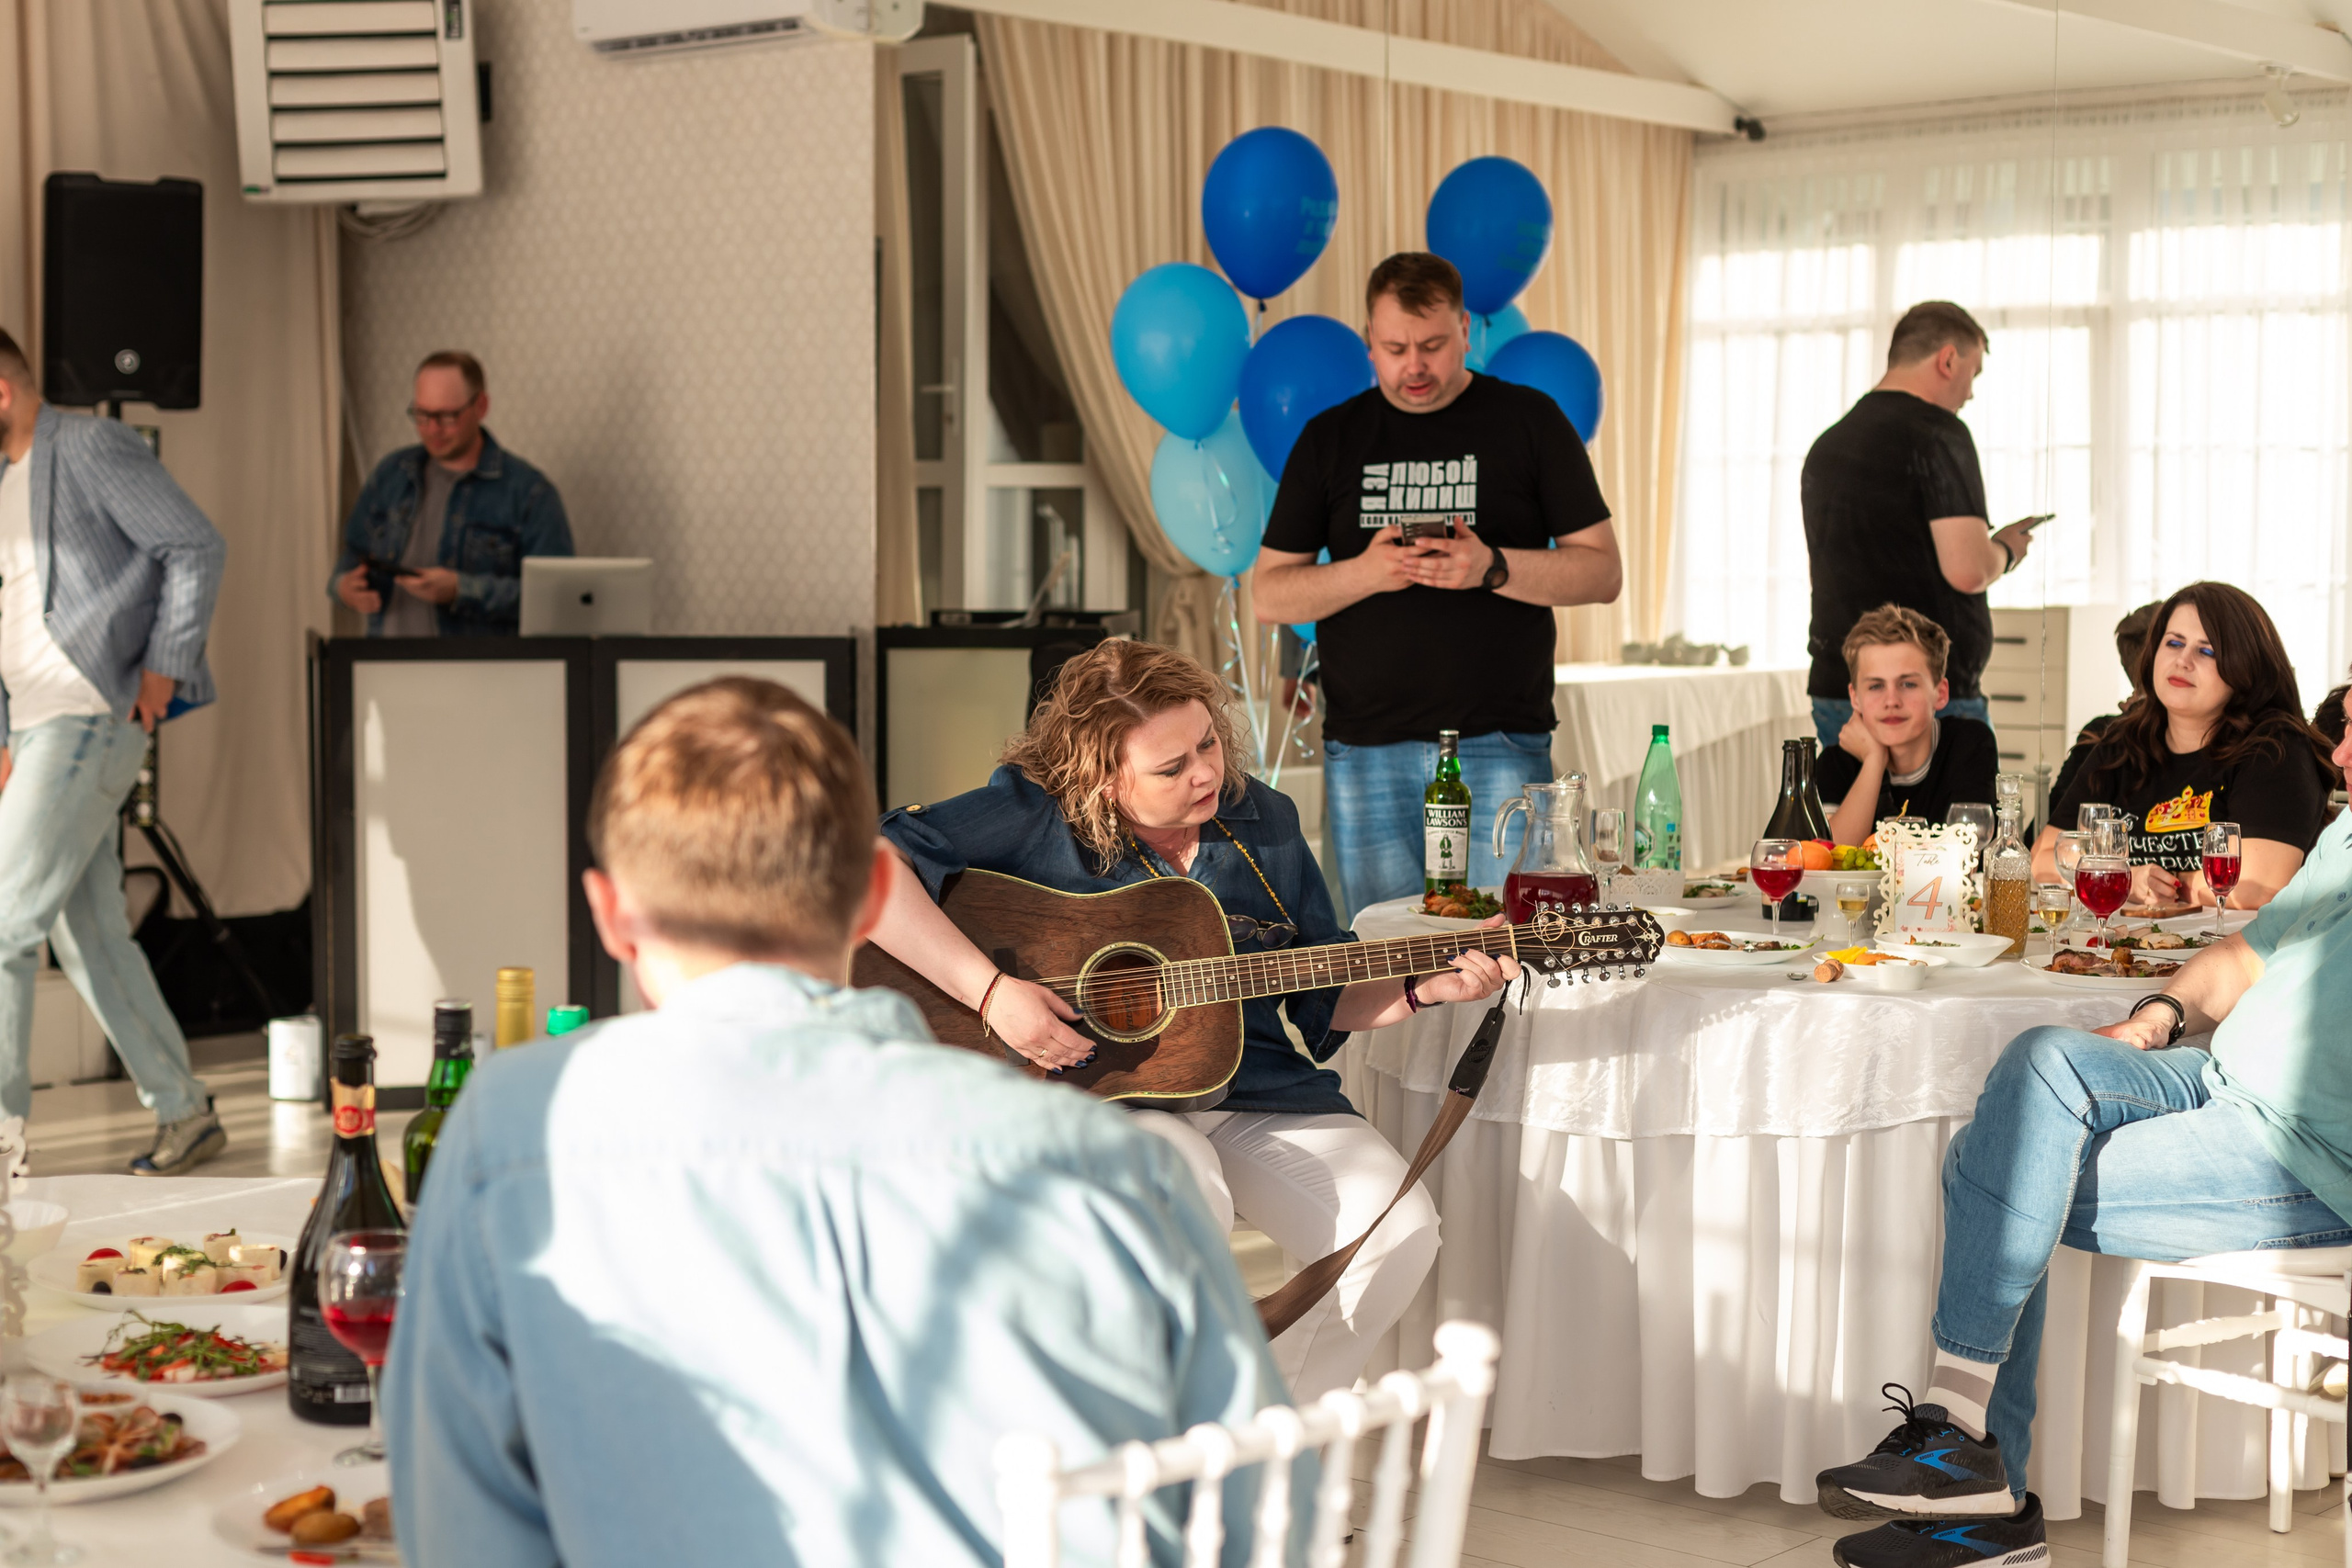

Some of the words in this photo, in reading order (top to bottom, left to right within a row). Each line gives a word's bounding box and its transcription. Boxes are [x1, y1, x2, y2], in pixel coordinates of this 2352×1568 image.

[1362, 463, 1390, 491] ЗА
[1390, 454, 1477, 487] ЛЮБОЙ
[1361, 496, 1387, 511] Я
[1388, 484, 1476, 511] КИПИШ
[1428, 809, 1465, 818] WILLIAM
[1426, 818, 1467, 827] LAWSON'S
[1914, 852, 1940, 867] Table
[1906, 876, 1943, 919] 4
[1578, 931, 1618, 946] CRAFTER
